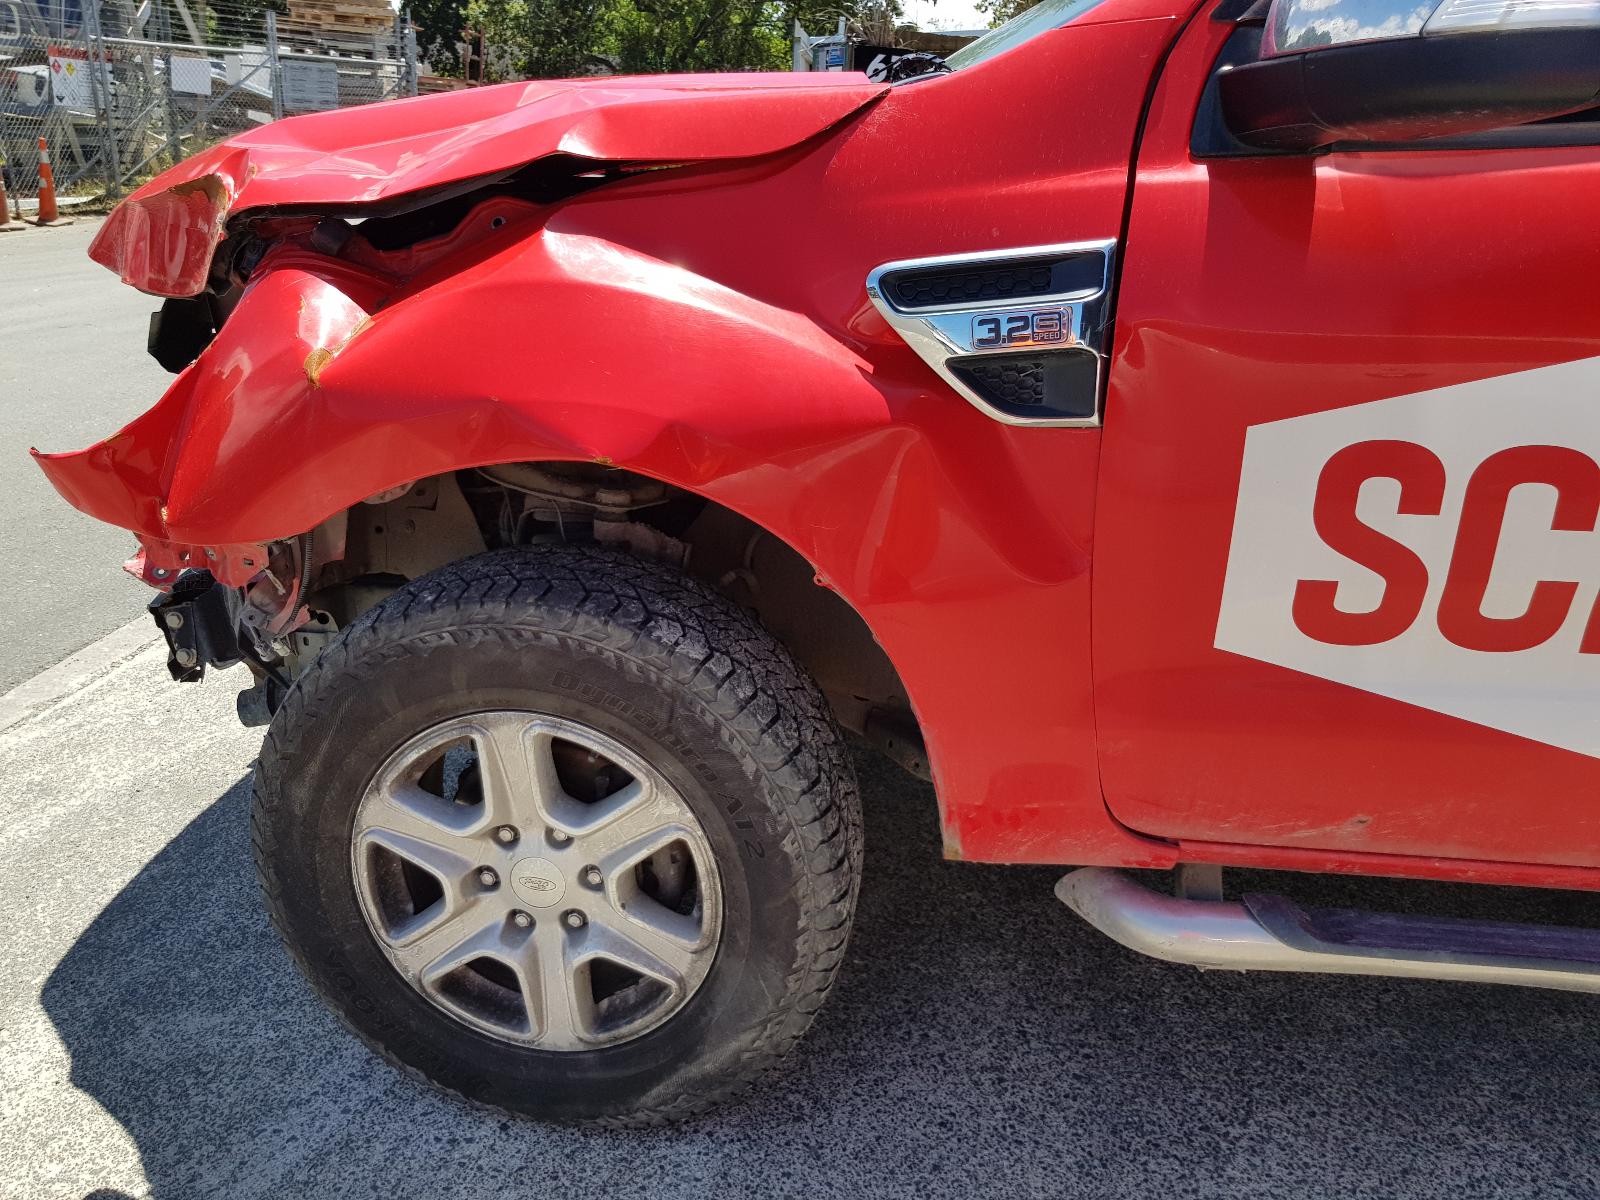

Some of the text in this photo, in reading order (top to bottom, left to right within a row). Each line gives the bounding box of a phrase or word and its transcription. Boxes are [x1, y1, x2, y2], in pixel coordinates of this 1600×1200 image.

[976, 314, 1031, 346] 3.2
[1033, 332, 1061, 342] SPEED
[1292, 439, 1600, 655] SC
